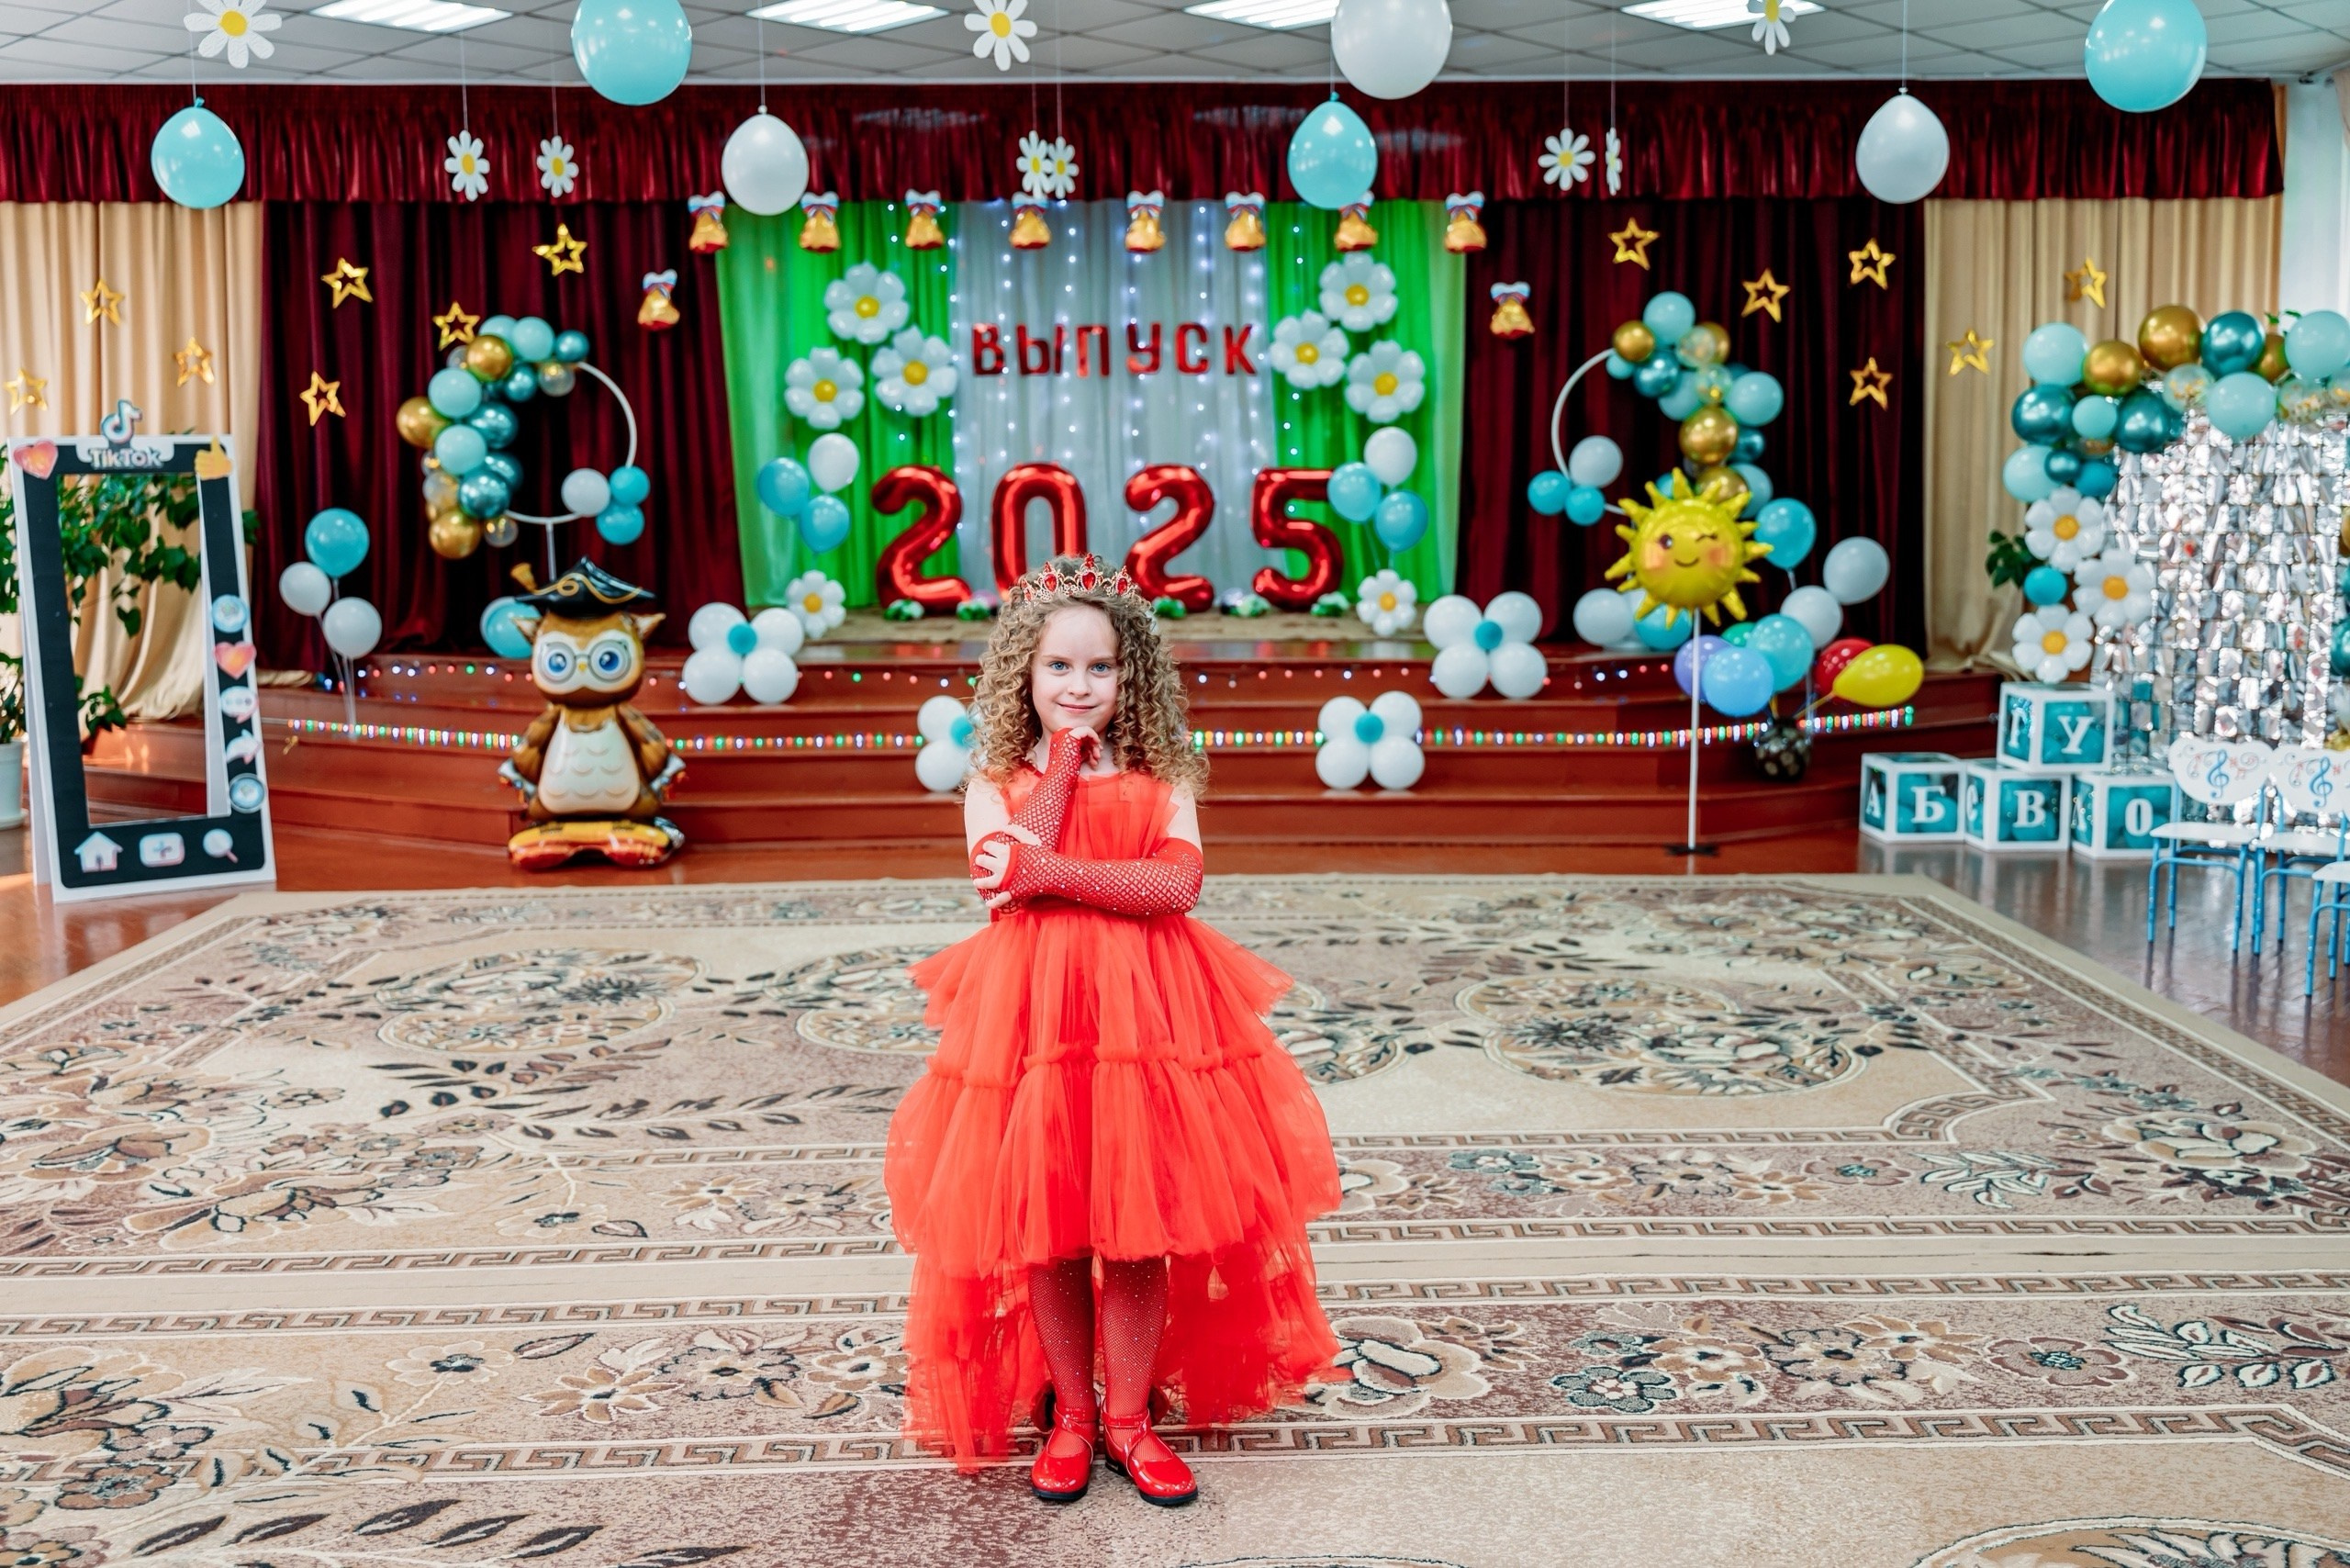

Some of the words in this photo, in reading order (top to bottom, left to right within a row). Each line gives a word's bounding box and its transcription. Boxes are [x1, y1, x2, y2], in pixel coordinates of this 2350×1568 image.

[972, 322, 1257, 377] ВЫПУСК
[89, 446, 163, 469] TikTok
[871, 463, 1344, 612] 2025
[2057, 715, 2095, 755] У
[1910, 785, 1946, 823] Б
[2014, 791, 2047, 828] В
